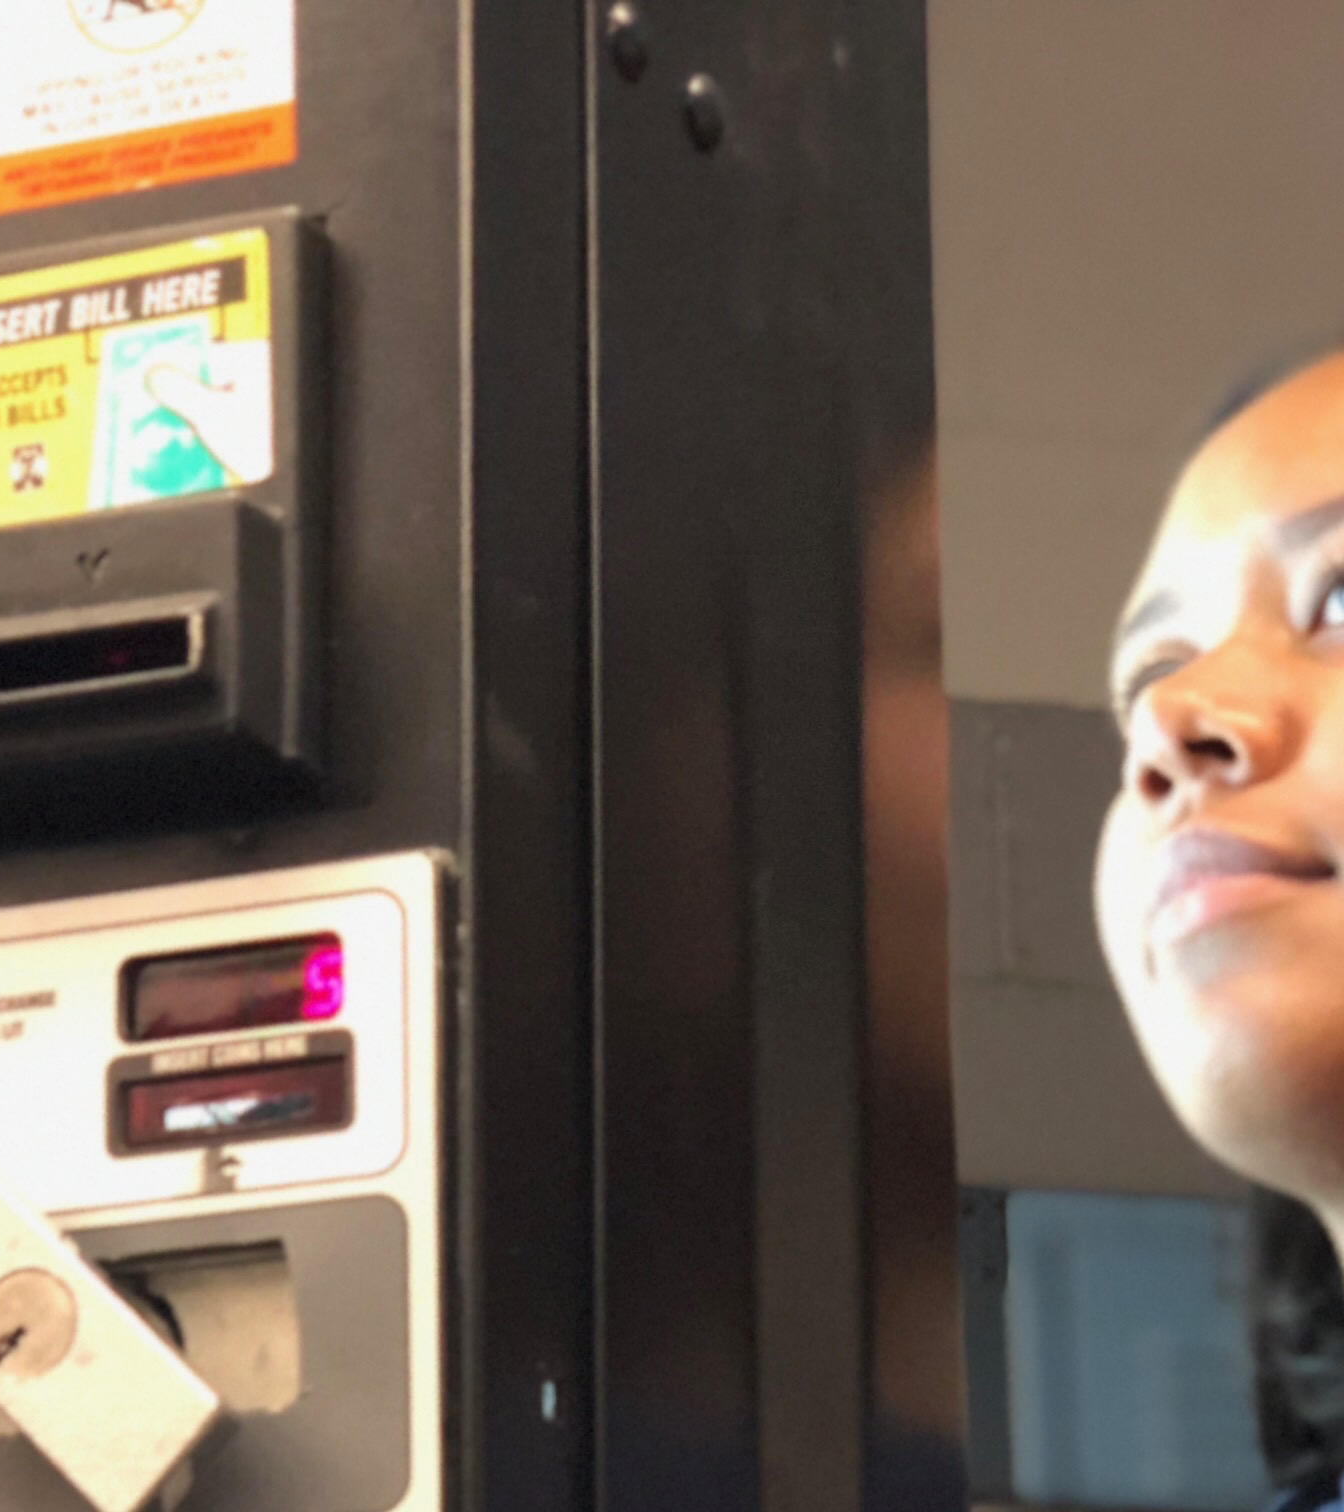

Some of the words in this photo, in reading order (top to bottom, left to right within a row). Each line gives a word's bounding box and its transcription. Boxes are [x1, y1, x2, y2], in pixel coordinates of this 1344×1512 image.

[68, 284, 130, 332] BILL
[141, 268, 222, 315] HERE
[7, 398, 66, 428] BILLS
